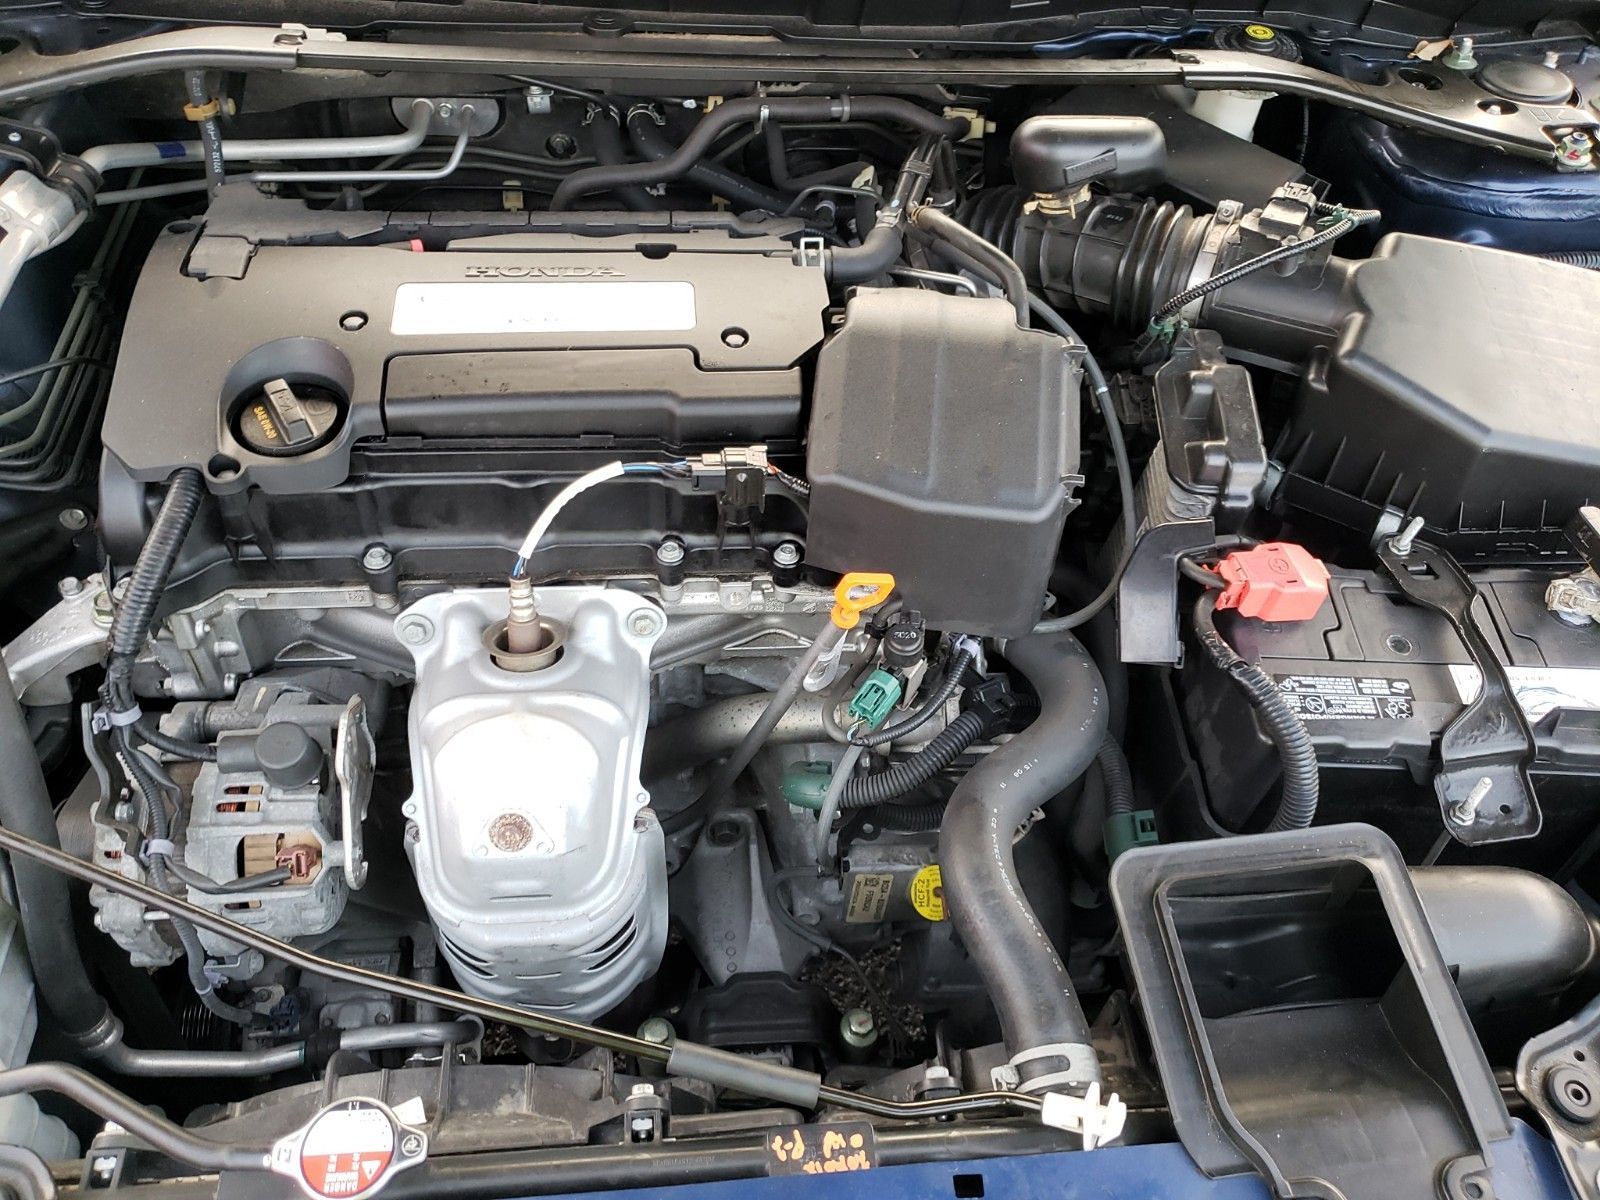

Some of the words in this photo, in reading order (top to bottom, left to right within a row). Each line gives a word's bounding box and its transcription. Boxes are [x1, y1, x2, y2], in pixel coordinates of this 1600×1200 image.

[464, 265, 626, 278] HONDA
[253, 406, 268, 420] SAE
[917, 879, 926, 908] HCF-2
